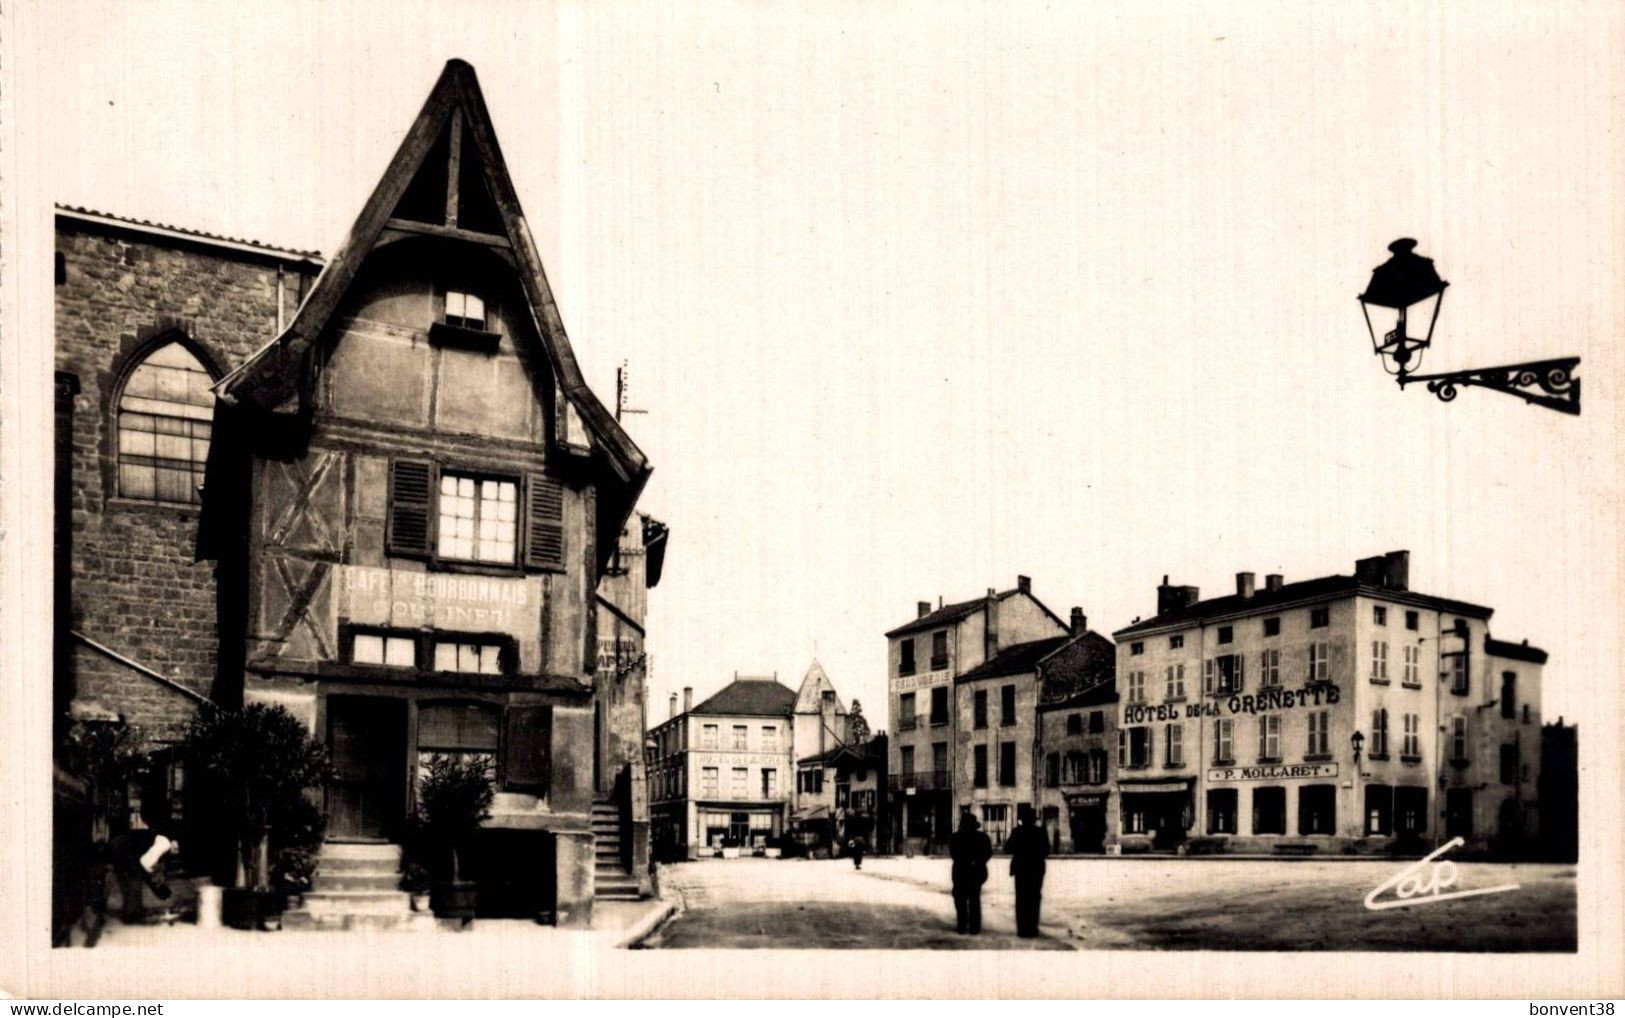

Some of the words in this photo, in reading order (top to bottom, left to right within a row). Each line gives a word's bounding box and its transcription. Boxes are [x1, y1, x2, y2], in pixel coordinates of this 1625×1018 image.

[413, 572, 527, 605] BOURBONNAIS
[1186, 704, 1200, 718] DE
[1205, 702, 1221, 716] LA
[1228, 685, 1340, 715] GRENETTE
[1241, 765, 1321, 779] MOLLARET
